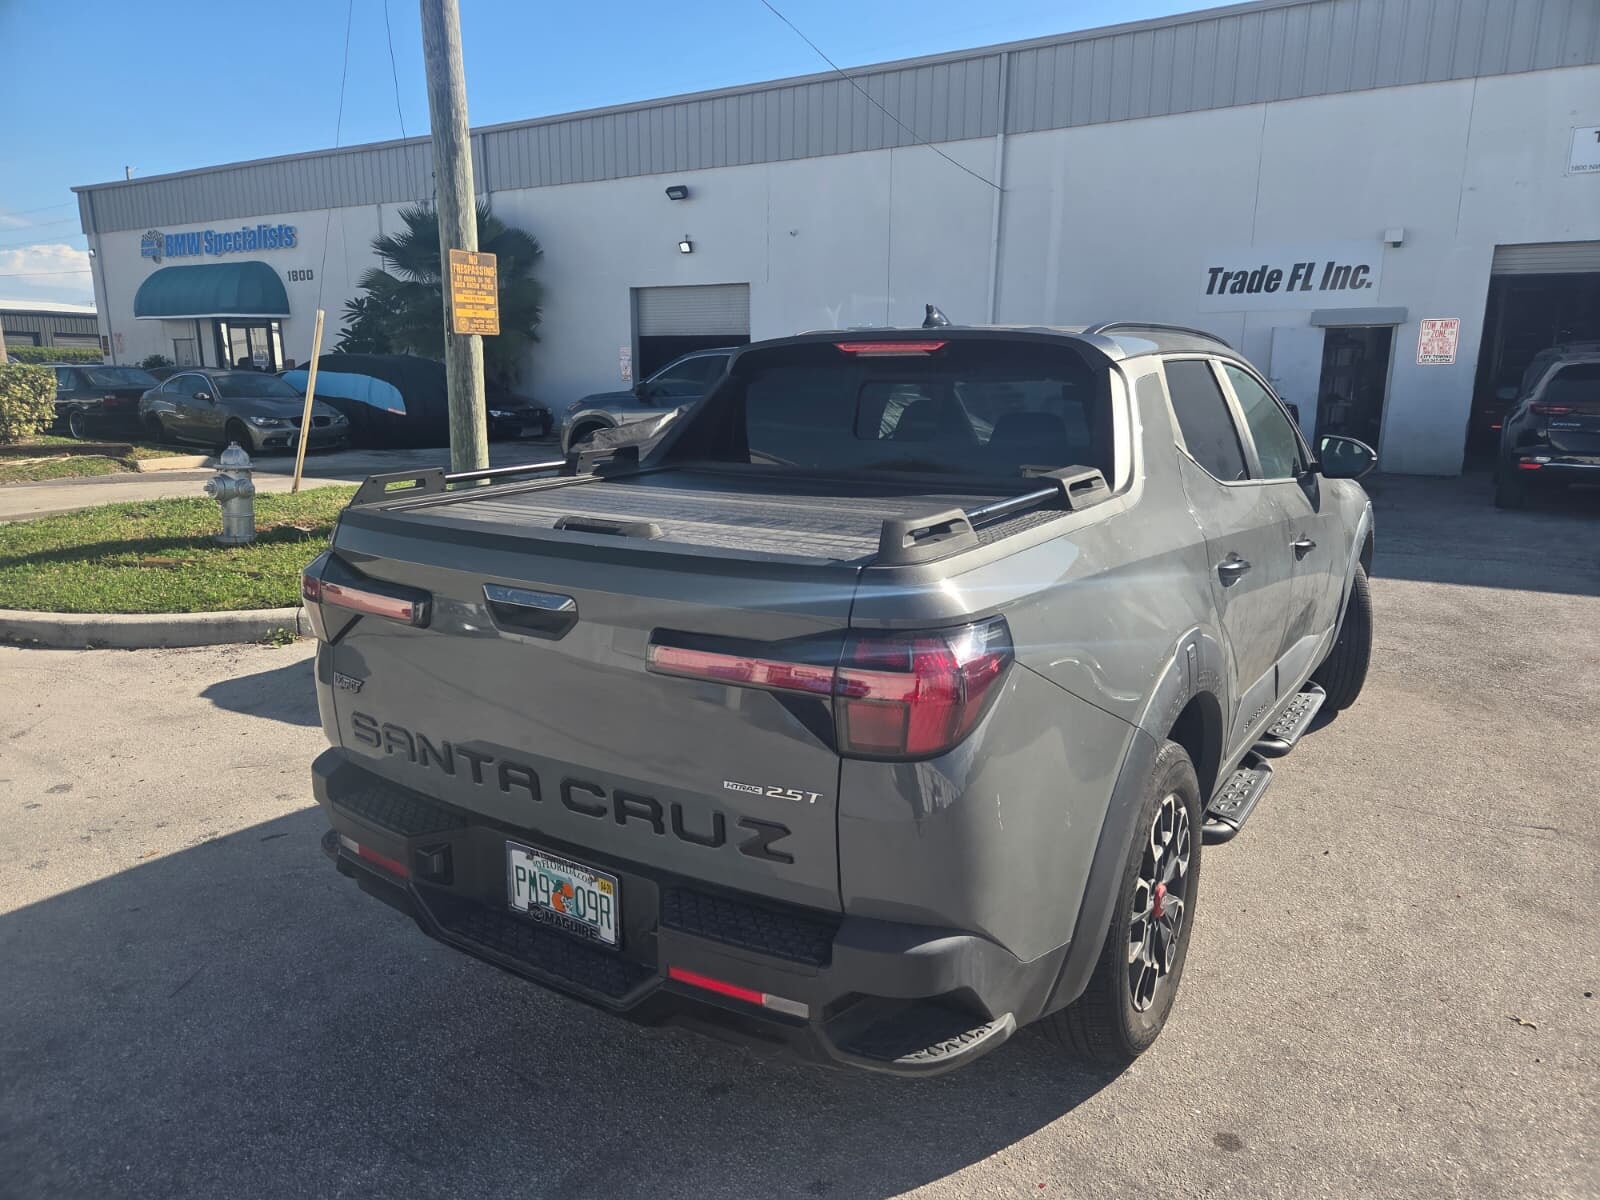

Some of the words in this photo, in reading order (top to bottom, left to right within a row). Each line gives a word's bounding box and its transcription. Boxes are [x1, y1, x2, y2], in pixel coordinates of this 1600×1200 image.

[165, 232, 201, 257] BMW
[204, 224, 297, 257] Specialists
[468, 254, 478, 265] NO
[287, 269, 314, 282] 1800
[453, 263, 495, 277] TRESPASSING
[1206, 265, 1283, 295] Trade
[1286, 262, 1316, 292] FL
[1319, 261, 1373, 291] Inc.
[1424, 320, 1437, 329] TOW
[1440, 320, 1456, 329] AWAY
[1430, 329, 1447, 338] ZONE
[352, 710, 543, 802] SANTA
[559, 777, 794, 865] CRUZ
[724, 781, 762, 795] HTRAC
[515, 865, 551, 907] PM9
